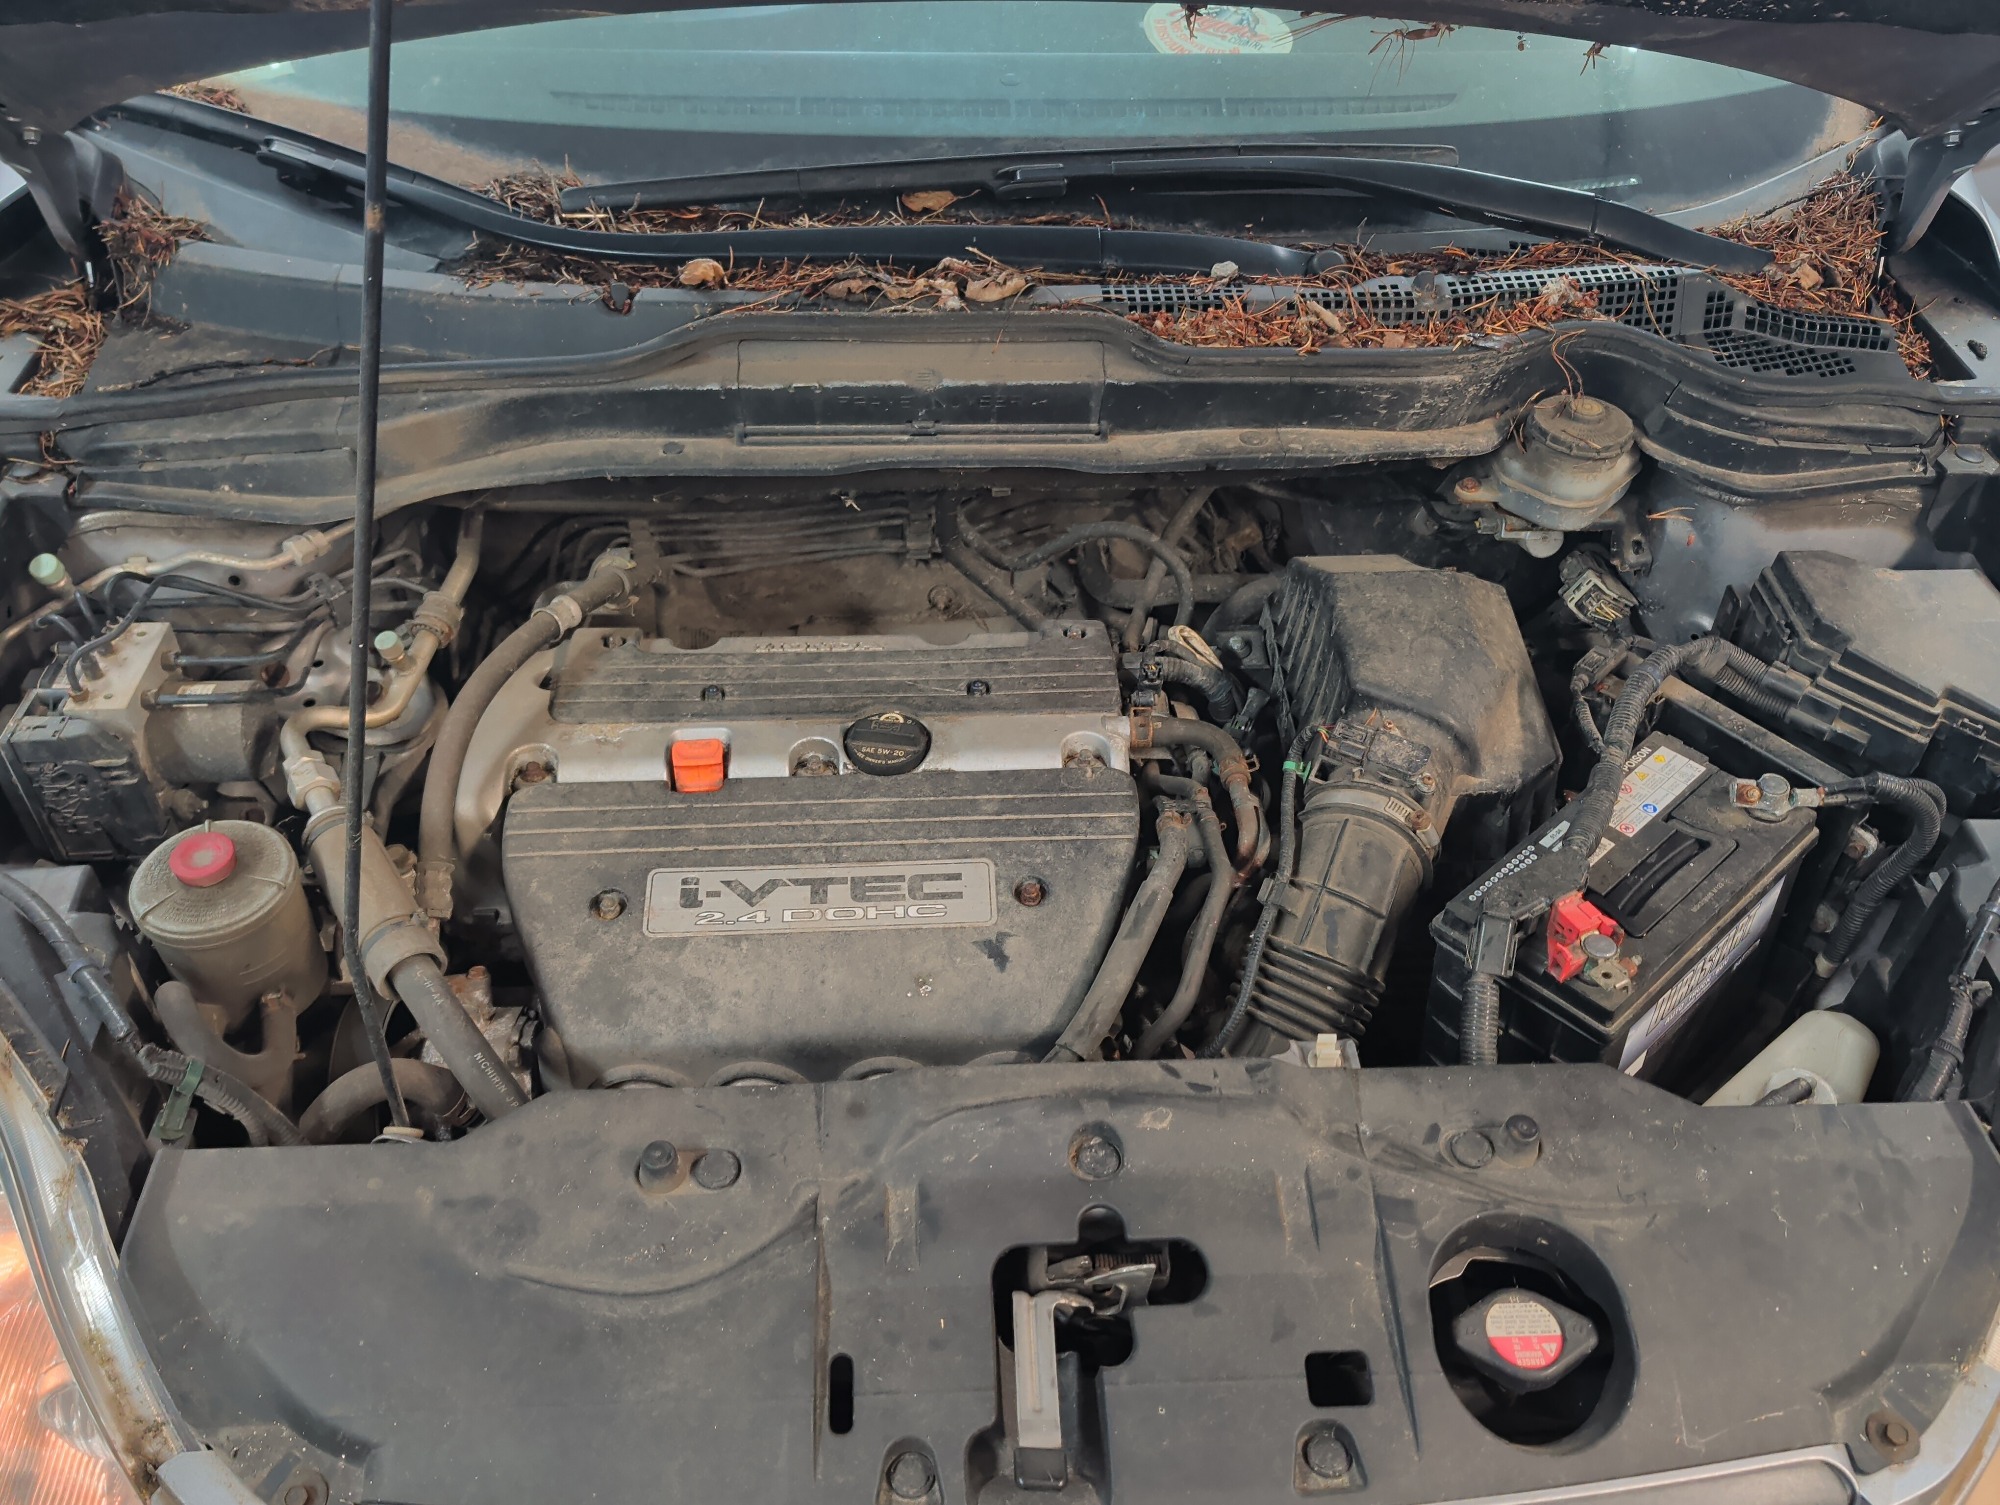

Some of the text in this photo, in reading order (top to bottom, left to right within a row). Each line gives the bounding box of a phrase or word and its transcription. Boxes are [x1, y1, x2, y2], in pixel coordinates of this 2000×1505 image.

[877, 747, 905, 756] 5W-20
[679, 872, 963, 908] i-VTEC
[695, 903, 948, 925] 2.4 DOHC
[473, 1052, 507, 1093] NICHIRIN
[1517, 1358, 1546, 1366] DANGER
